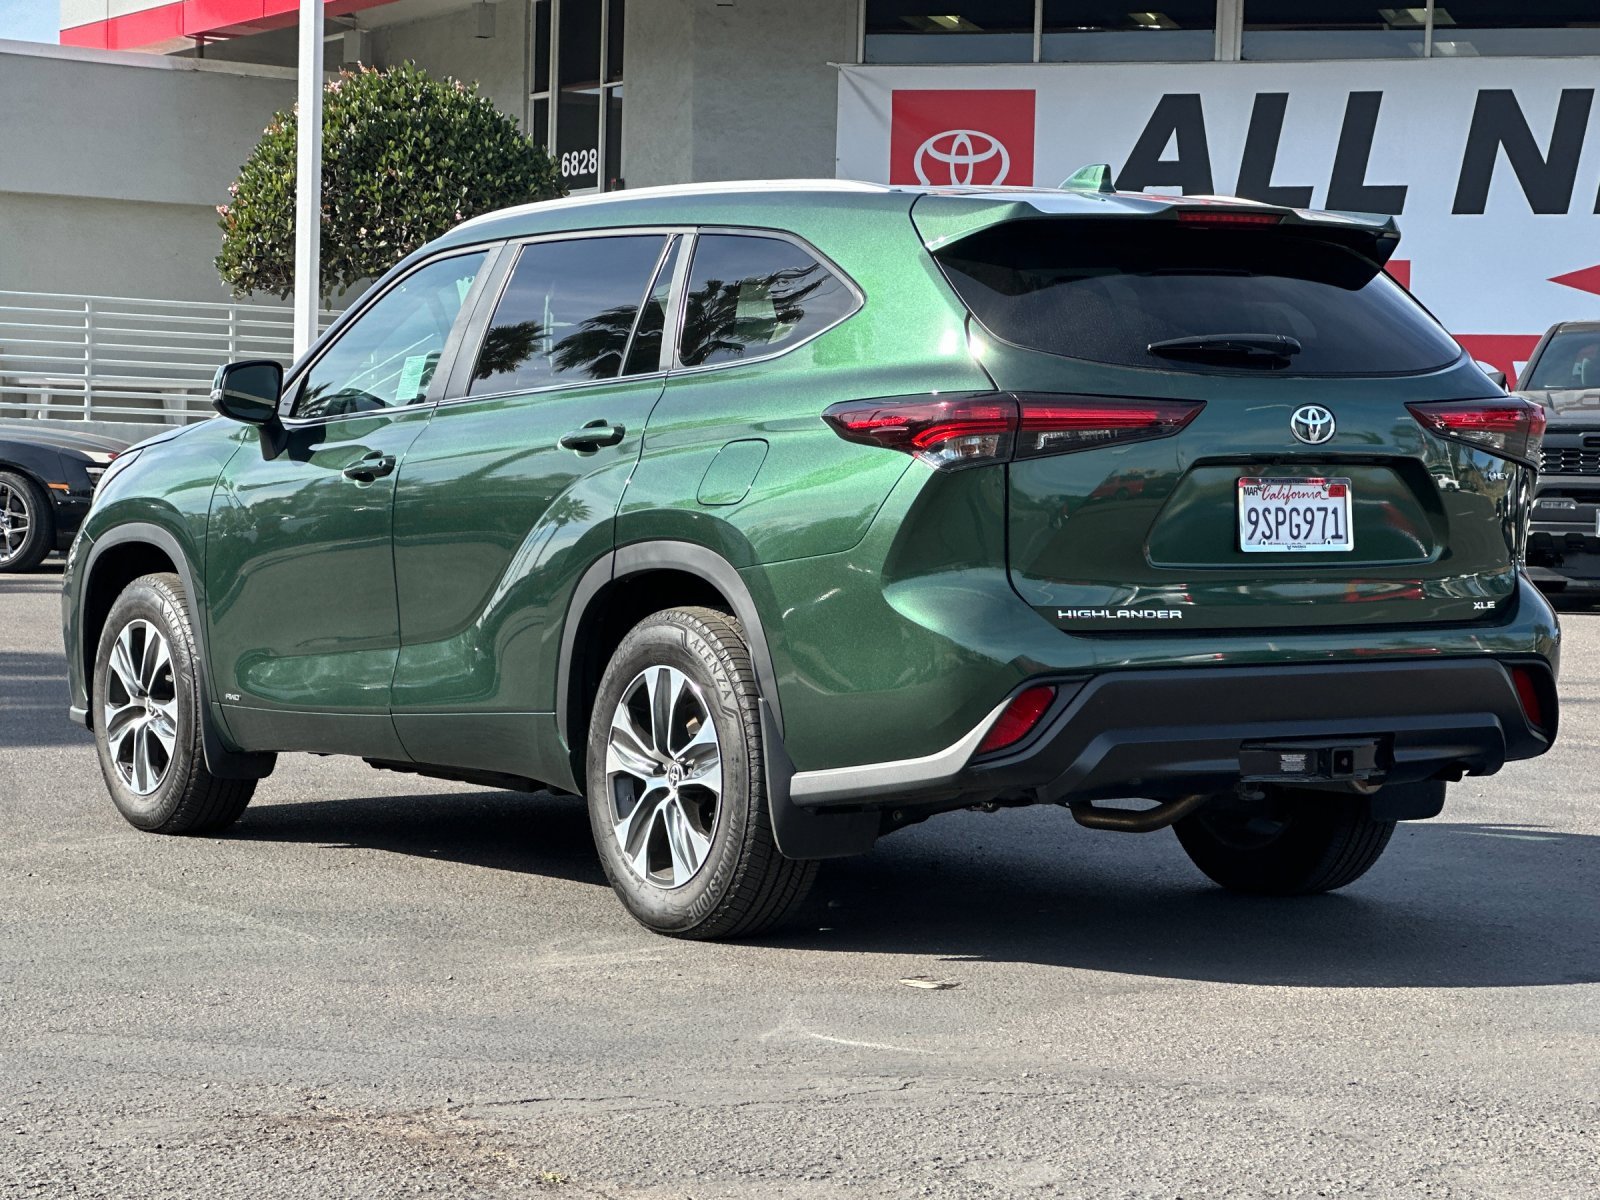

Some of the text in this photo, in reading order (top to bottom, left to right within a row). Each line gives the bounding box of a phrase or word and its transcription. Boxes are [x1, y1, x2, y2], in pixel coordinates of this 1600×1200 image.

[561, 148, 598, 178] 6828
[1111, 88, 1600, 216] ALL N
[1244, 486, 1259, 496] MAR
[1261, 485, 1330, 505] California
[1247, 507, 1343, 540] 9SPG971
[1057, 609, 1183, 619] HIGHLANDER
[1473, 600, 1496, 610] XLE
